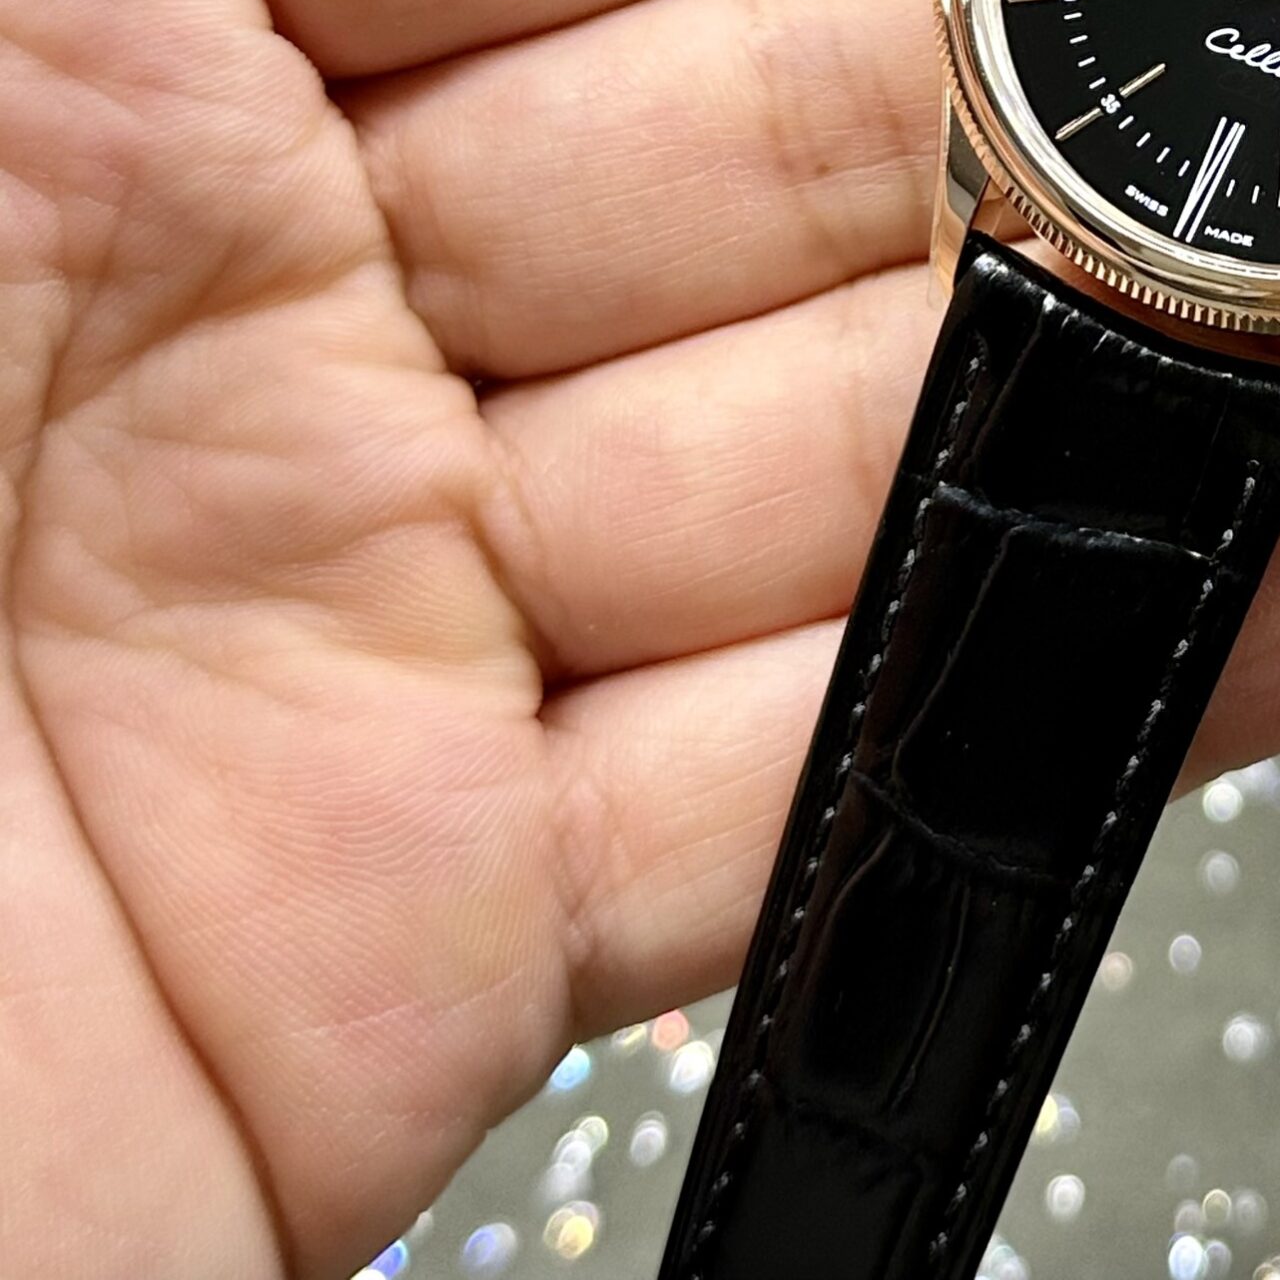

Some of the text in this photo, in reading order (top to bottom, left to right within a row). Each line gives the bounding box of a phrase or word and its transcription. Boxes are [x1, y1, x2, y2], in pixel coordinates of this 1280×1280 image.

[1100, 94, 1122, 114] 35
[1124, 184, 1255, 248] SWISS MADE
